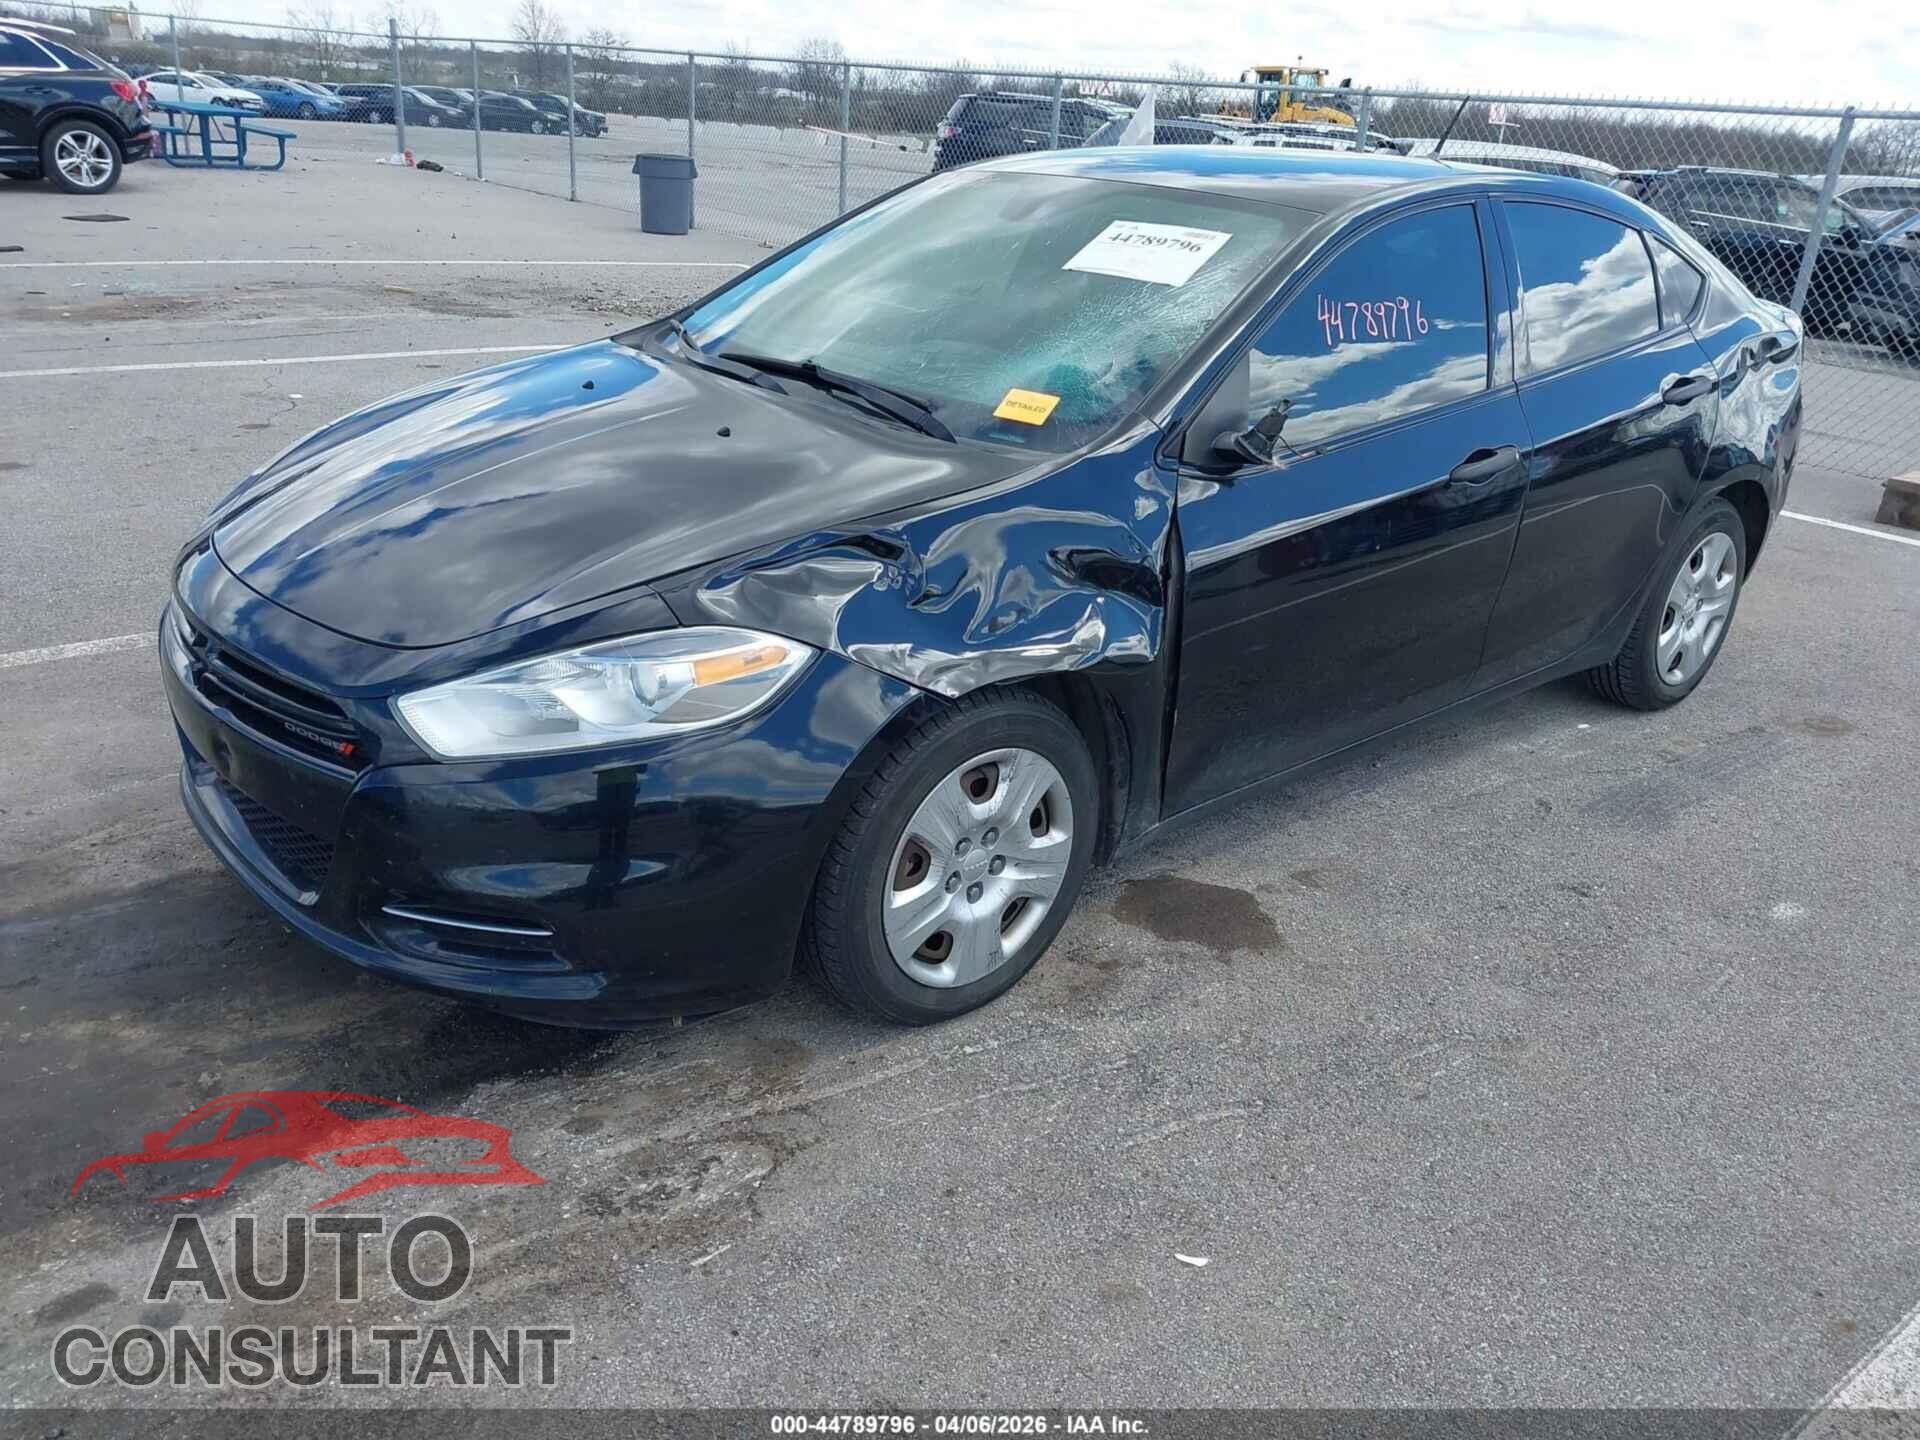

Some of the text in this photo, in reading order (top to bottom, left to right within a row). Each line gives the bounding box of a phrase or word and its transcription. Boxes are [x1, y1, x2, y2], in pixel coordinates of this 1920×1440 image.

[1108, 231, 1203, 253] 44789796
[1317, 293, 1429, 346] 44789796
[1006, 400, 1047, 414] DETAILED
[284, 722, 340, 749] DODGE
